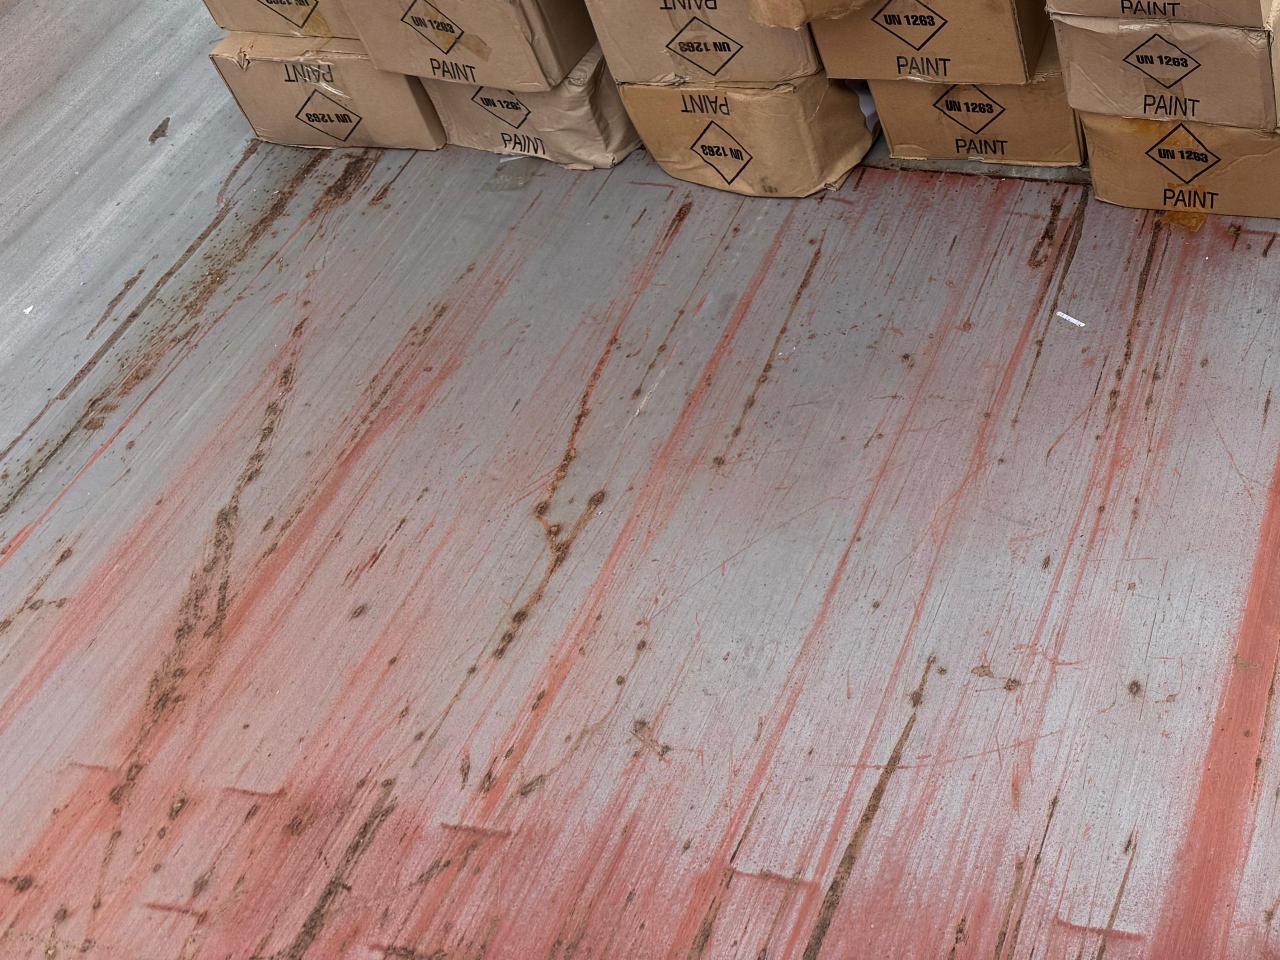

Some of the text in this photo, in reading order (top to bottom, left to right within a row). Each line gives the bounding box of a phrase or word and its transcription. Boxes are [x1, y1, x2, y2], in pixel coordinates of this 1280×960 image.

[410, 15, 456, 34] UN 1263
[884, 14, 936, 27] UN 1263
[678, 41, 732, 53] UN 1263
[430, 58, 476, 82] PAINT
[896, 56, 951, 77] PAINT
[1136, 54, 1188, 68] UN 1263
[284, 63, 334, 83] PAINT
[681, 94, 730, 116] PAINT
[945, 100, 994, 114] UN 1263
[1144, 94, 1200, 117] PAINT
[500, 132, 546, 155] PAINT
[956, 138, 1008, 156] PAINT
[1158, 148, 1208, 164] UN 1263
[1163, 188, 1219, 210] PAINT
